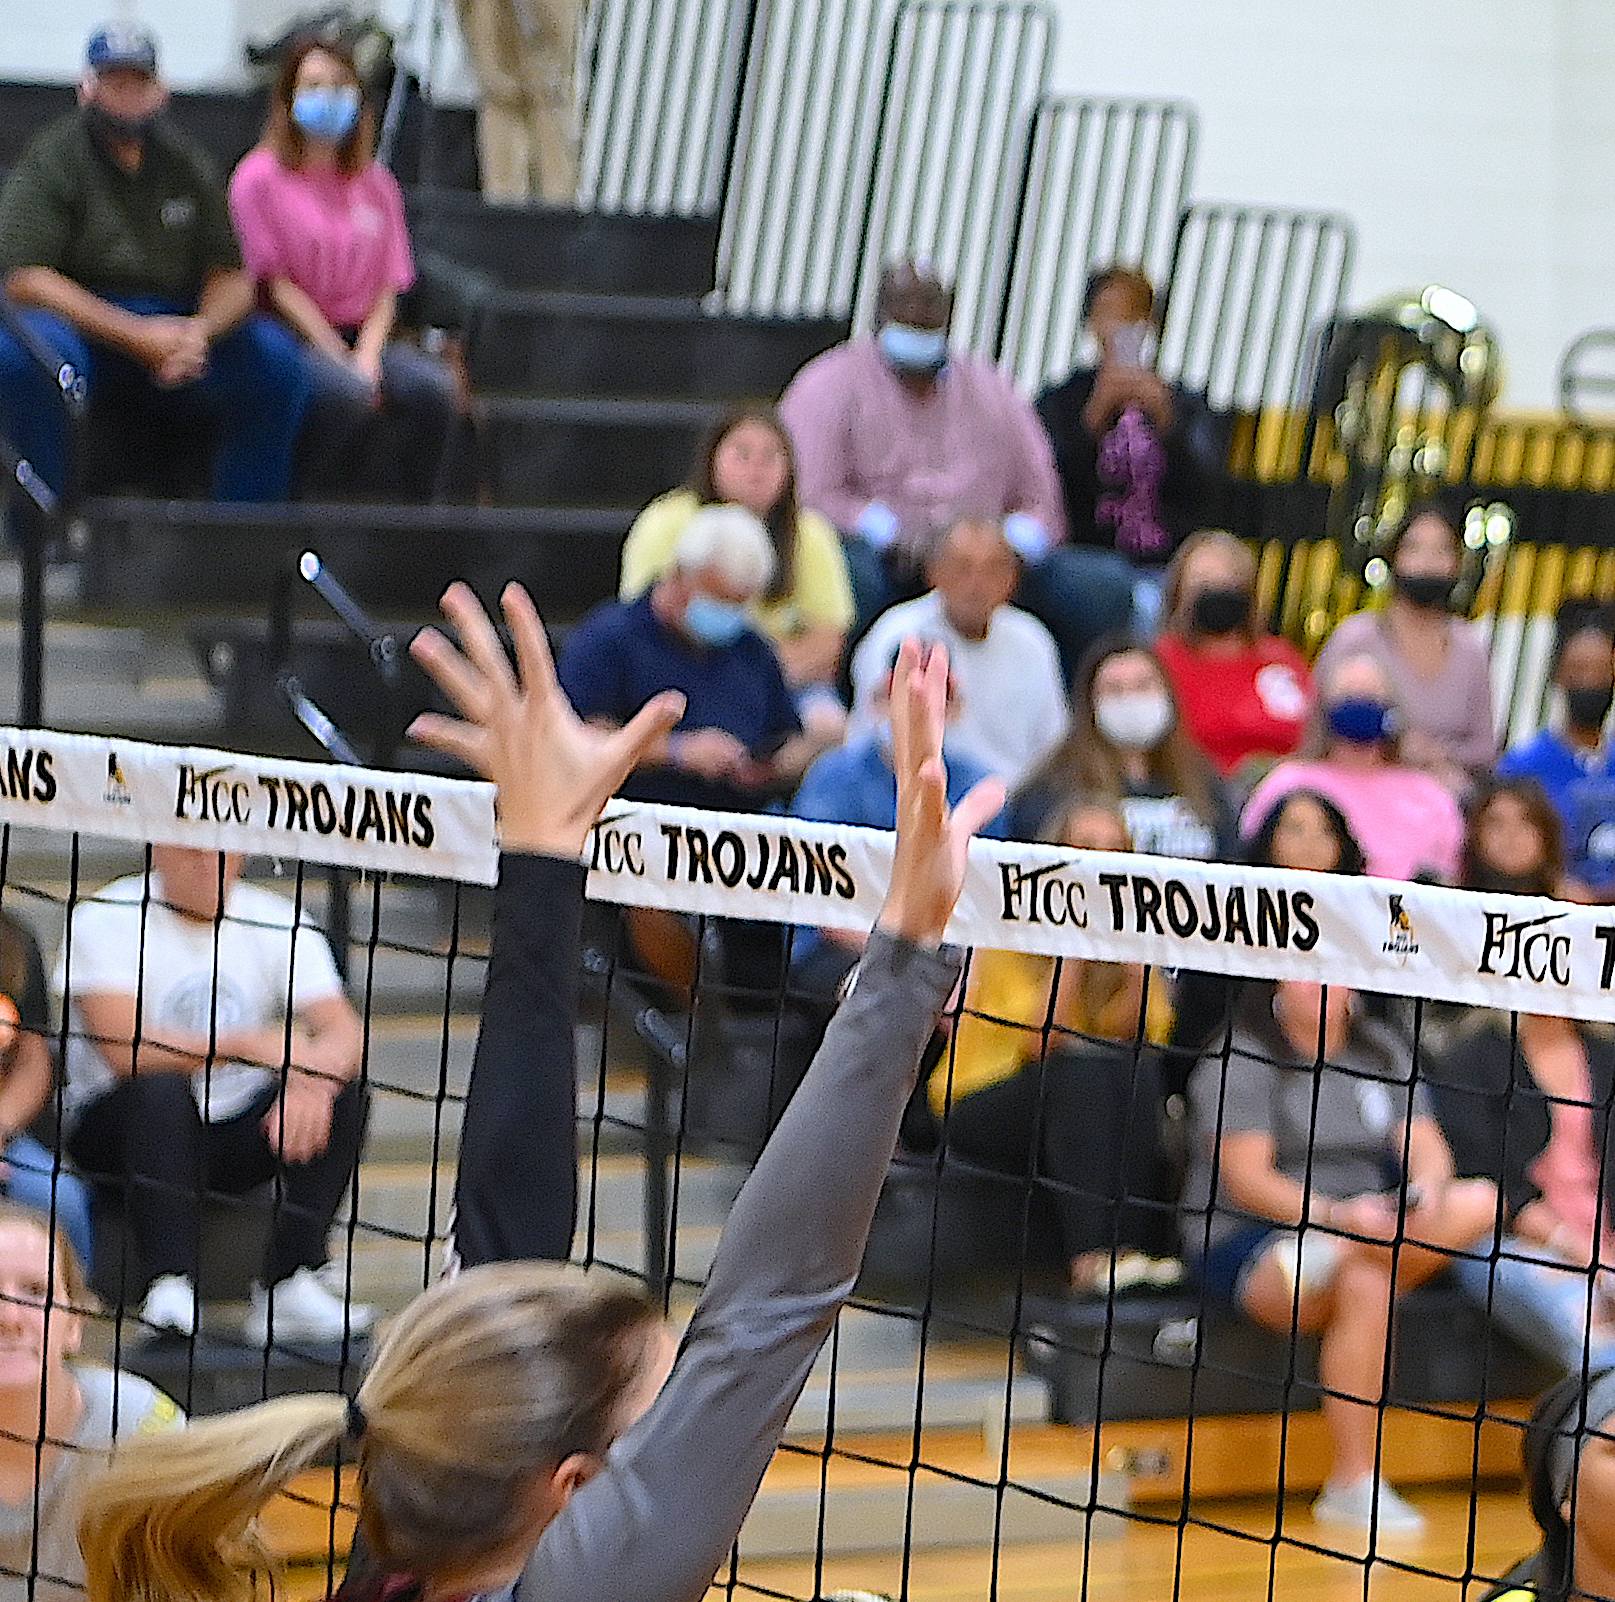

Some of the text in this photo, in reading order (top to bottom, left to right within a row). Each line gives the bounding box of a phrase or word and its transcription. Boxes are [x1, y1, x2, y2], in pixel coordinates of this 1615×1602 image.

[0, 748, 57, 803] NS
[258, 776, 435, 848] TROJANS
[661, 825, 856, 900] TROJANS
[1099, 873, 1319, 952] TROJANS
